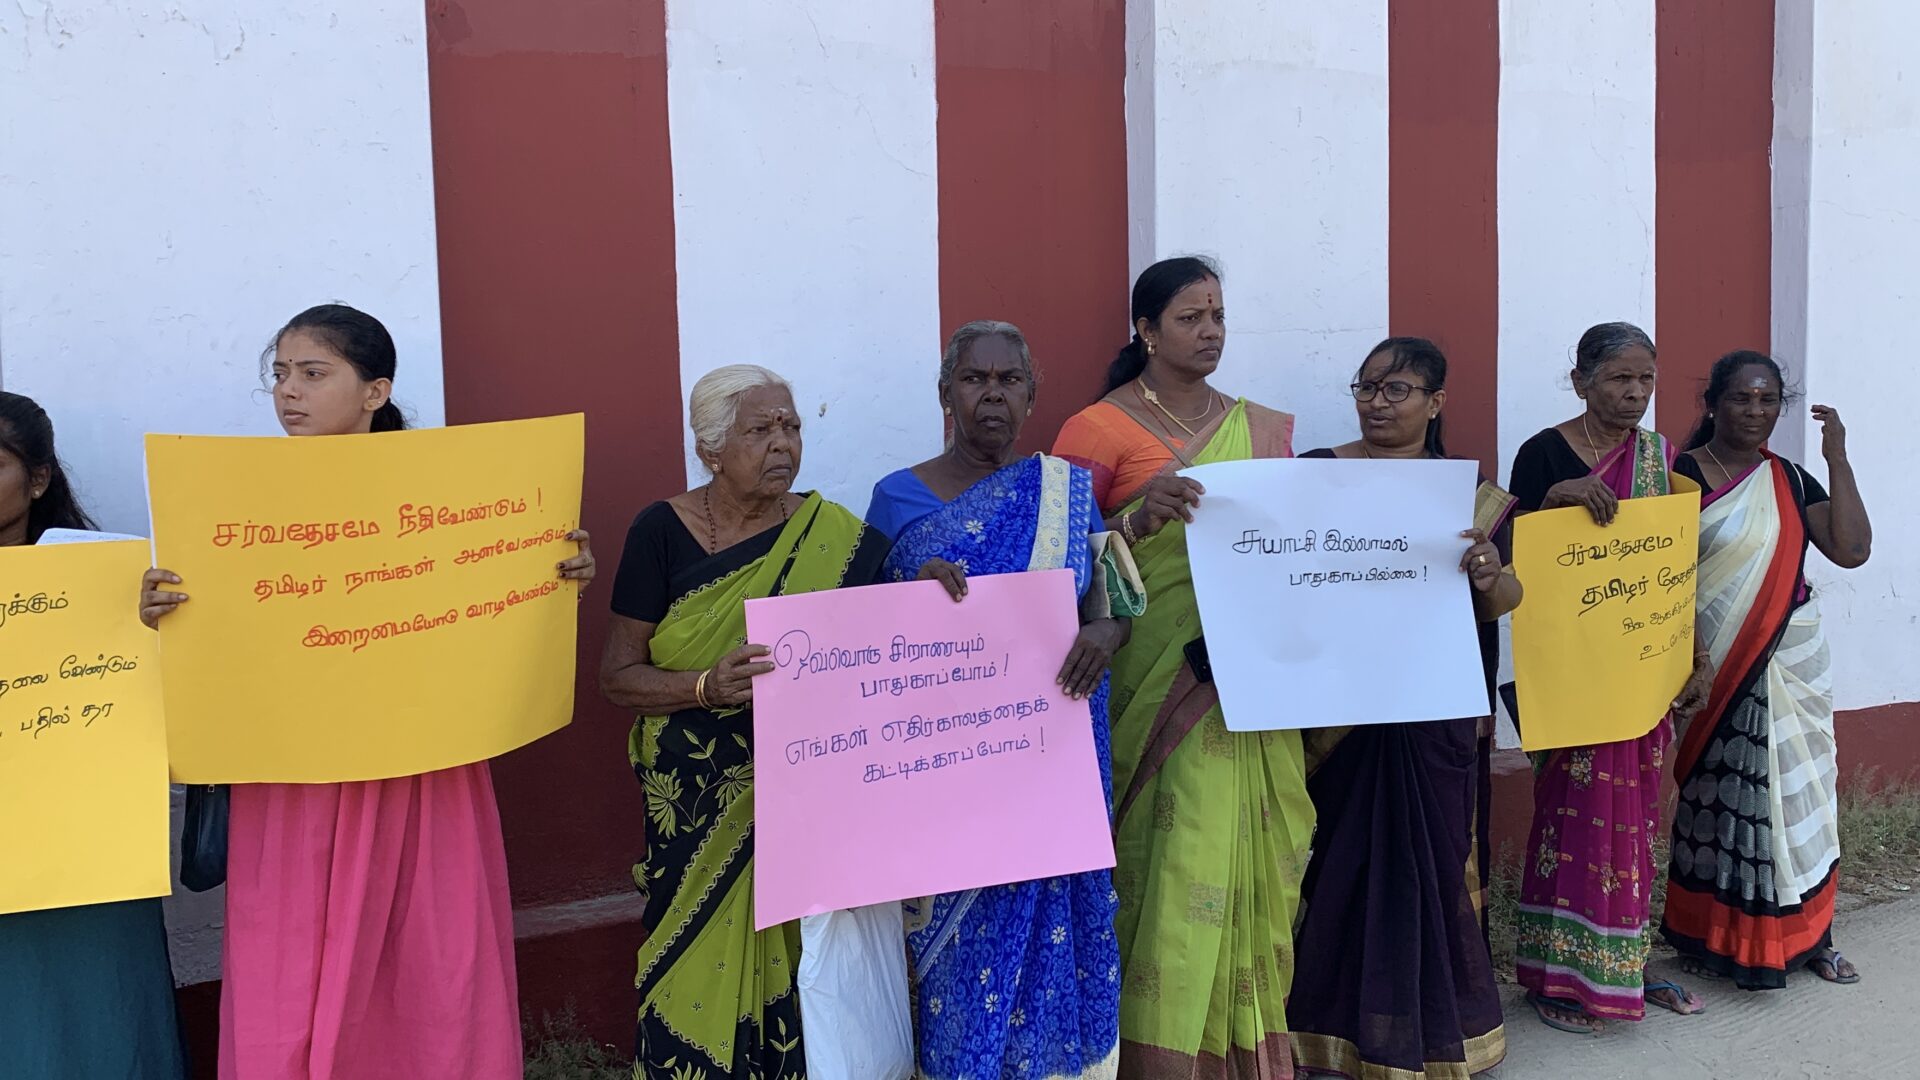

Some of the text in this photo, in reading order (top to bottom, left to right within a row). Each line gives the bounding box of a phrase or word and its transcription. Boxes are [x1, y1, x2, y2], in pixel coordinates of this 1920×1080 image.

[213, 519, 380, 549] சர்வதேசமே
[1323, 529, 1409, 552] இல்லாமல்
[345, 555, 435, 594] நாங்கள்
[1578, 575, 1649, 617] தமிழர்
[60, 654, 138, 679] வேண்டும்
[774, 630, 881, 680] ஒவ்வொரு
[21, 706, 69, 739] பதில்
[785, 695, 1049, 765] எங்கள் எதிர்காலத்தைக்
